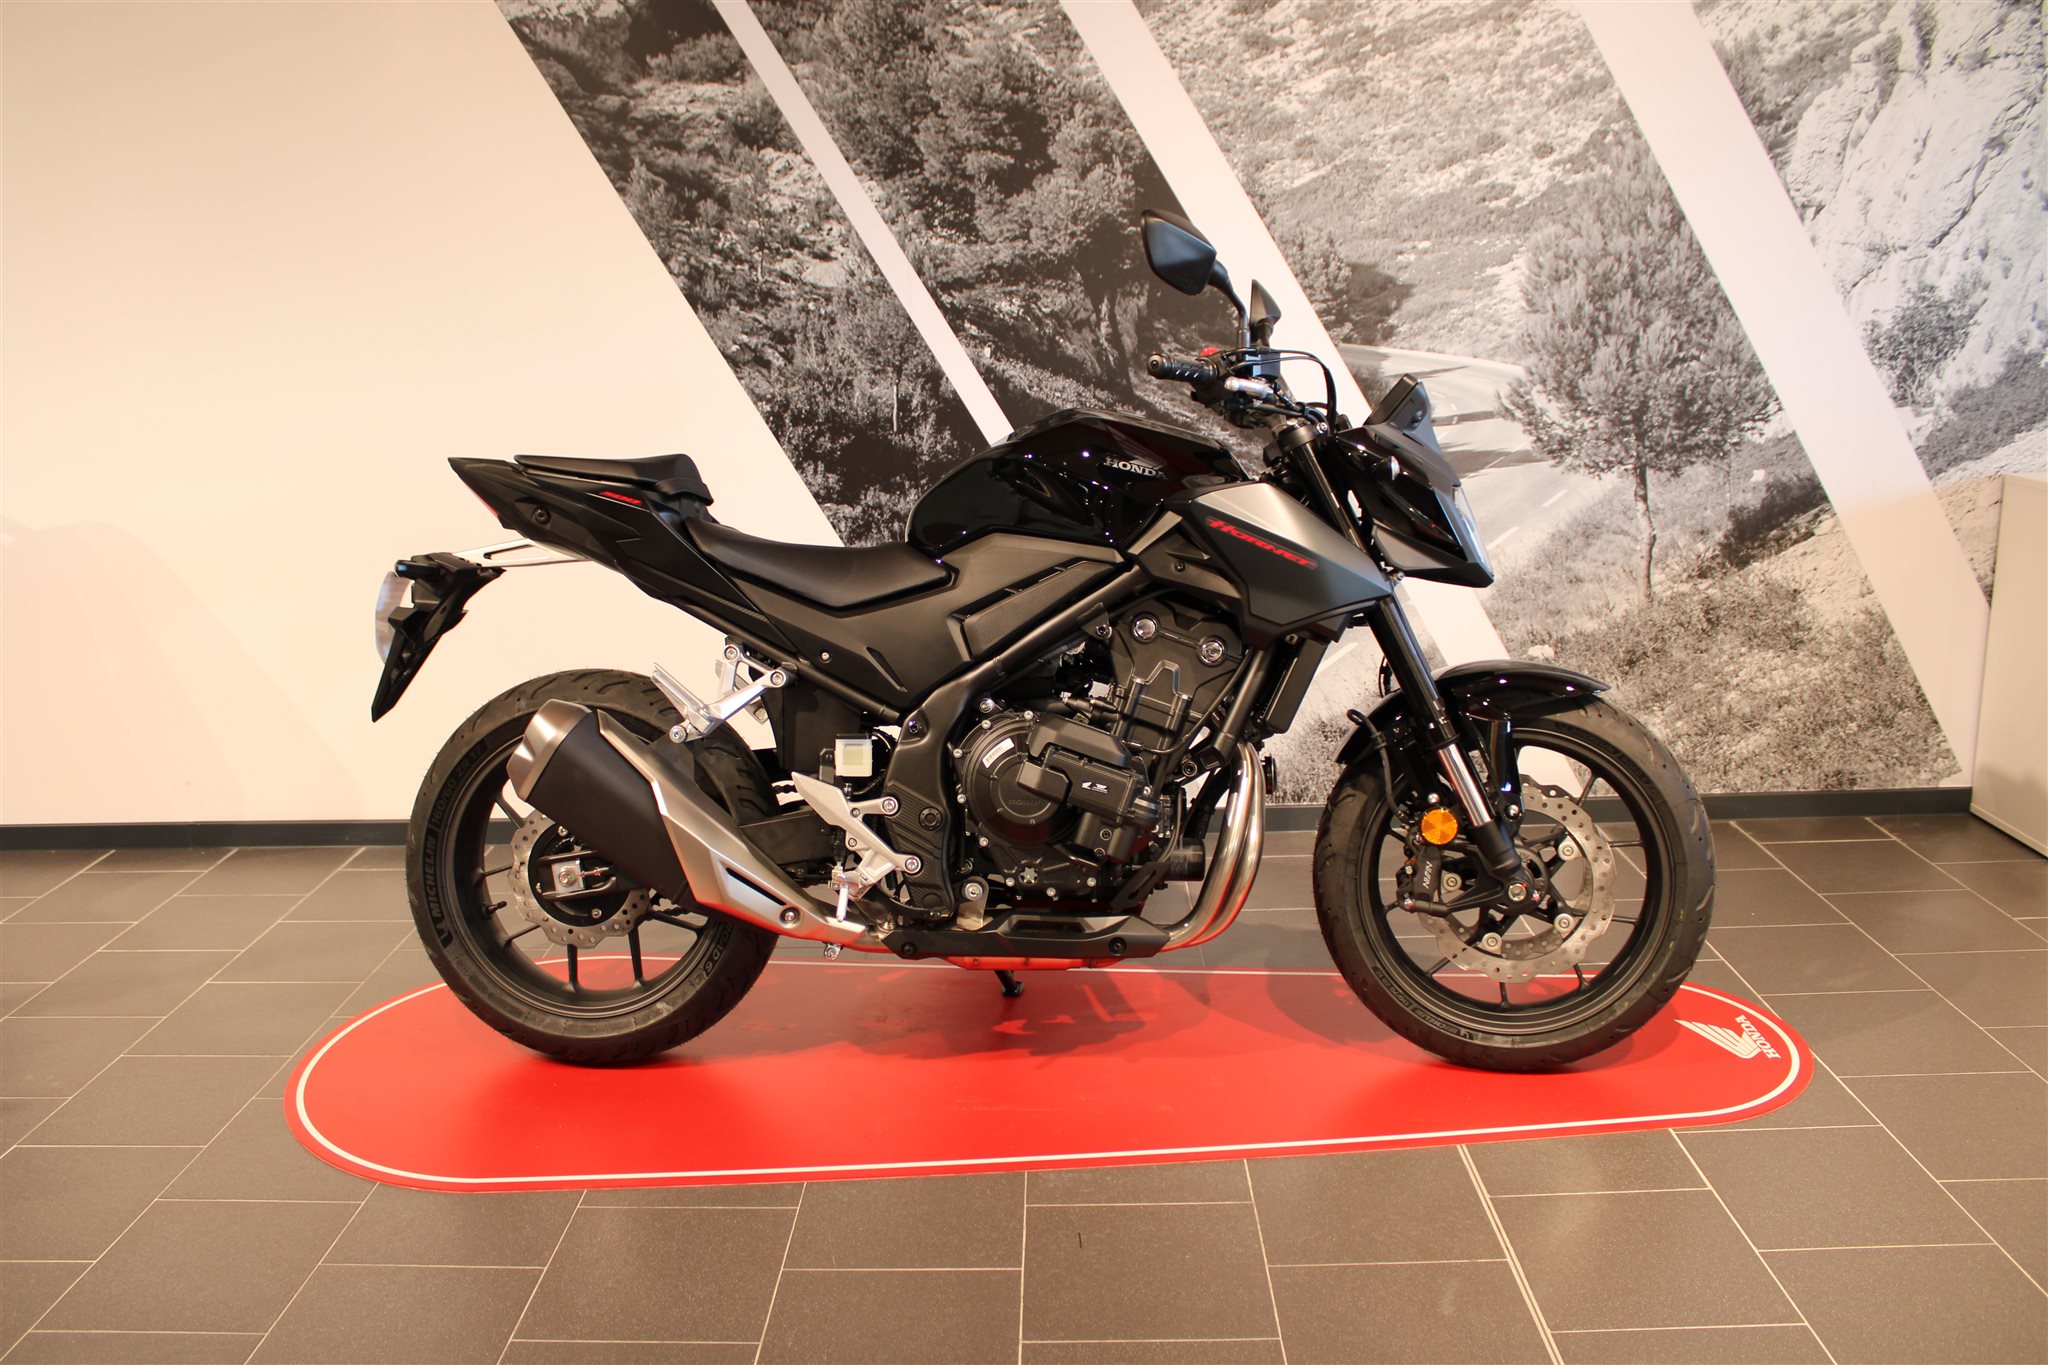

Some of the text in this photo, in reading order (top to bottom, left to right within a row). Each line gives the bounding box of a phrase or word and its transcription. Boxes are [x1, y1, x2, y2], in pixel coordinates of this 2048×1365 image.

[1103, 455, 1168, 480] HONDA
[423, 835, 445, 921] MICHELIN
[1735, 1015, 1781, 1059] HONDA
